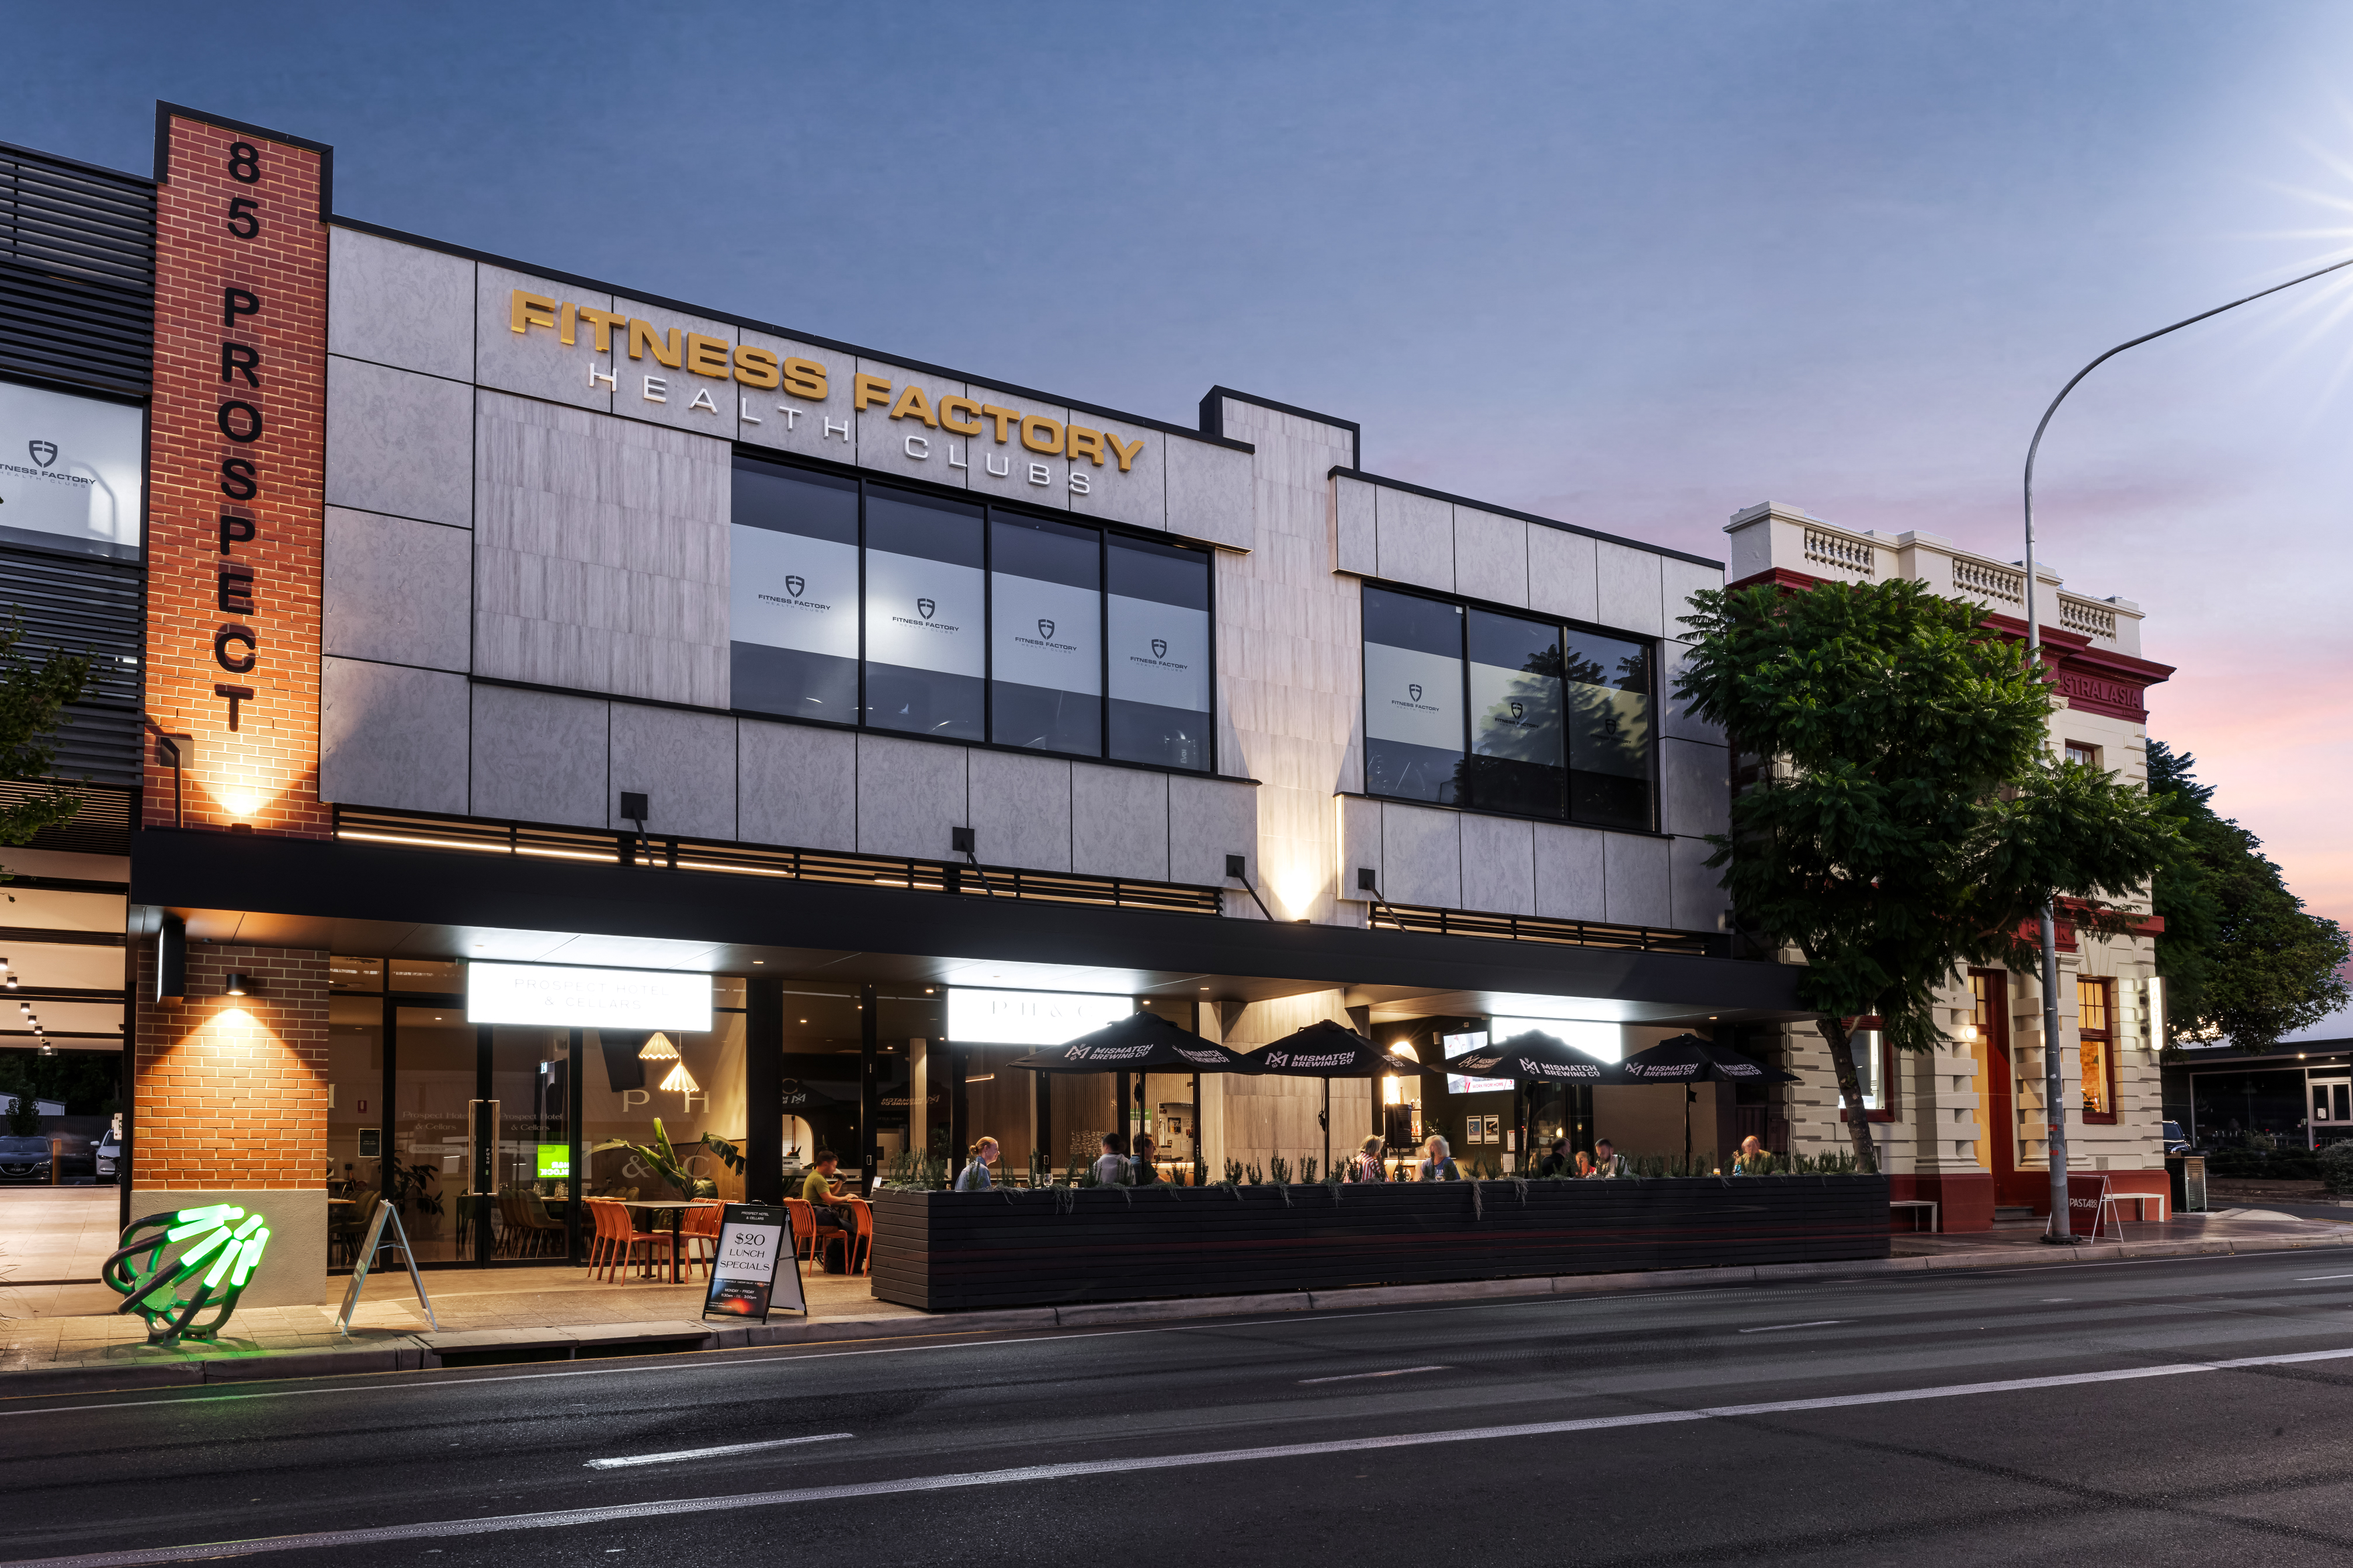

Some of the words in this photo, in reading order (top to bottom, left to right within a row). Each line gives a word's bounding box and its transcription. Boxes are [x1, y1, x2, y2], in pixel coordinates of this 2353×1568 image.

[226, 141, 261, 239] 85
[511, 288, 828, 401] FITNESS
[854, 372, 1145, 472] FACTORY
[589, 362, 849, 443] HEALTH
[904, 434, 1091, 495] CLUBS
[41, 471, 96, 485] FACTORY
[50, 479, 86, 488] CLUBS
[214, 287, 263, 732] PROSPECT
[758, 594, 792, 604] FITNESS
[794, 600, 831, 610] FACTORY
[893, 616, 923, 625] FITNESS
[925, 622, 959, 631] FACTORY
[1015, 637, 1044, 646] FITNESS
[1046, 642, 1077, 651] FACTORY
[1130, 656, 1157, 665] FITNESS
[1158, 661, 1188, 670] FACTORY
[515, 979, 607, 992] PROSPECT
[617, 983, 670, 996] HOTEL
[544, 996, 555, 1006] &
[565, 996, 641, 1010] CELLARS
[2151, 979, 2161, 1035] PASTA
[1094, 1044, 1154, 1055] MISMATCH
[1293, 1051, 1355, 1062] MISMATCH
[1291, 1059, 1339, 1068] BREWING
[1540, 1062, 1598, 1072] MISMATCH
[1646, 1063, 1698, 1072] MISMATCH
[1544, 1069, 1587, 1077] BREWING
[622, 1089, 650, 1112] P
[683, 1090, 710, 1113] H
[403, 1111, 442, 1119] Prospect
[622, 1155, 651, 1178] &
[683, 1155, 710, 1178] C
[2069, 1198, 2091, 1208] PASTA
[735, 1232, 765, 1246] $20
[730, 1249, 765, 1258] LUNCH
[720, 1260, 770, 1271] SPECIALS
